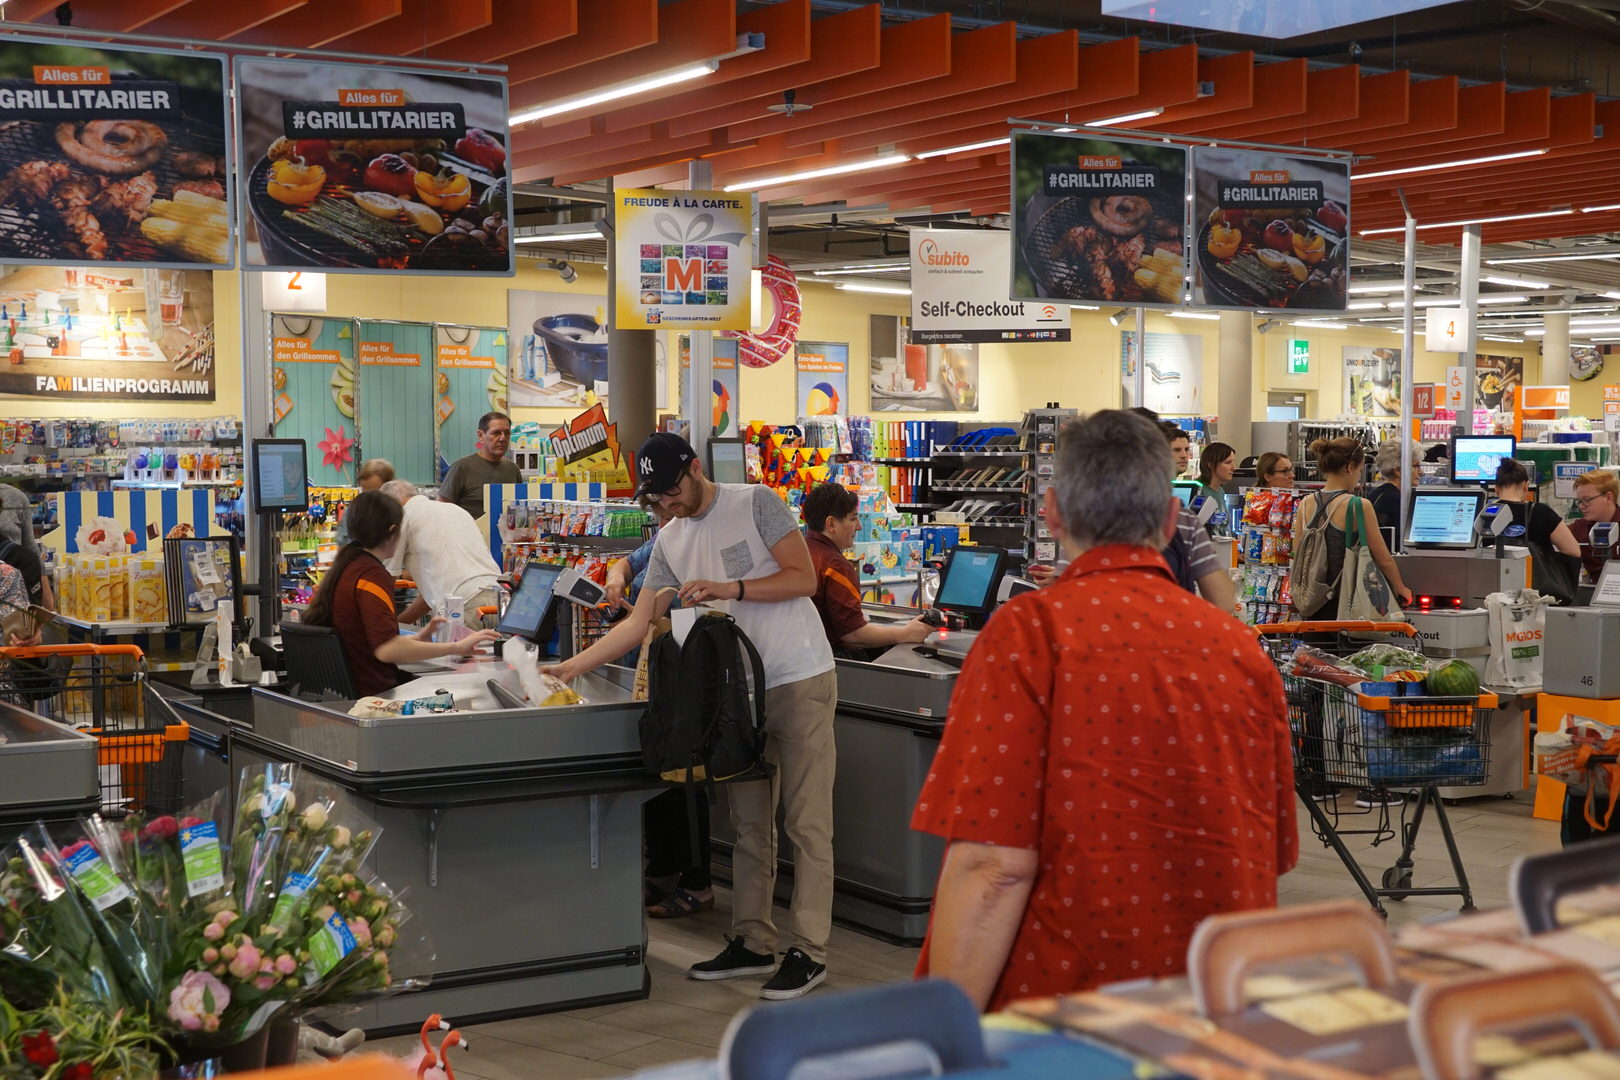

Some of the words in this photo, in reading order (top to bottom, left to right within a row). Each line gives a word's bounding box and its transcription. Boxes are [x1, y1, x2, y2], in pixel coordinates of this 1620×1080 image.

[42, 69, 78, 81] Alles
[82, 69, 103, 81] für
[0, 89, 171, 110] GRILLITARIER
[345, 92, 377, 103] Alles
[380, 92, 398, 103] für
[292, 110, 457, 129] #GRILLITARIER
[1083, 158, 1104, 168] Alles
[1105, 158, 1118, 168] für
[1049, 173, 1155, 188] #GRILLITARIER
[1254, 173, 1273, 182] Alles
[1274, 173, 1285, 182] für
[1223, 187, 1318, 201] #GRILLITARIER
[624, 197, 669, 207] FREUDE
[673, 196, 681, 208] À
[684, 199, 700, 208] LA
[702, 199, 743, 209] CARTE.
[927, 251, 970, 266] subito
[666, 258, 702, 291] M
[920, 300, 1025, 318] Self-Checkout
[1446, 320, 1455, 338] 4
[277, 340, 294, 349] Alles
[296, 340, 307, 349] für
[361, 344, 379, 353] Alles
[380, 344, 390, 353] für
[277, 352, 291, 360] den
[292, 352, 338, 361] Grillsommer.
[440, 347, 457, 355] Alles
[458, 348, 467, 356] für
[361, 355, 375, 363] den
[376, 355, 418, 364] Grillsommer.
[440, 358, 452, 366] den
[453, 358, 493, 367] Grillsommer.
[36, 376, 209, 395] FAMILIENPROGRAMM
[551, 422, 608, 463] Optimum
[640, 456, 654, 475] NY
[1580, 675, 1594, 687] 46
